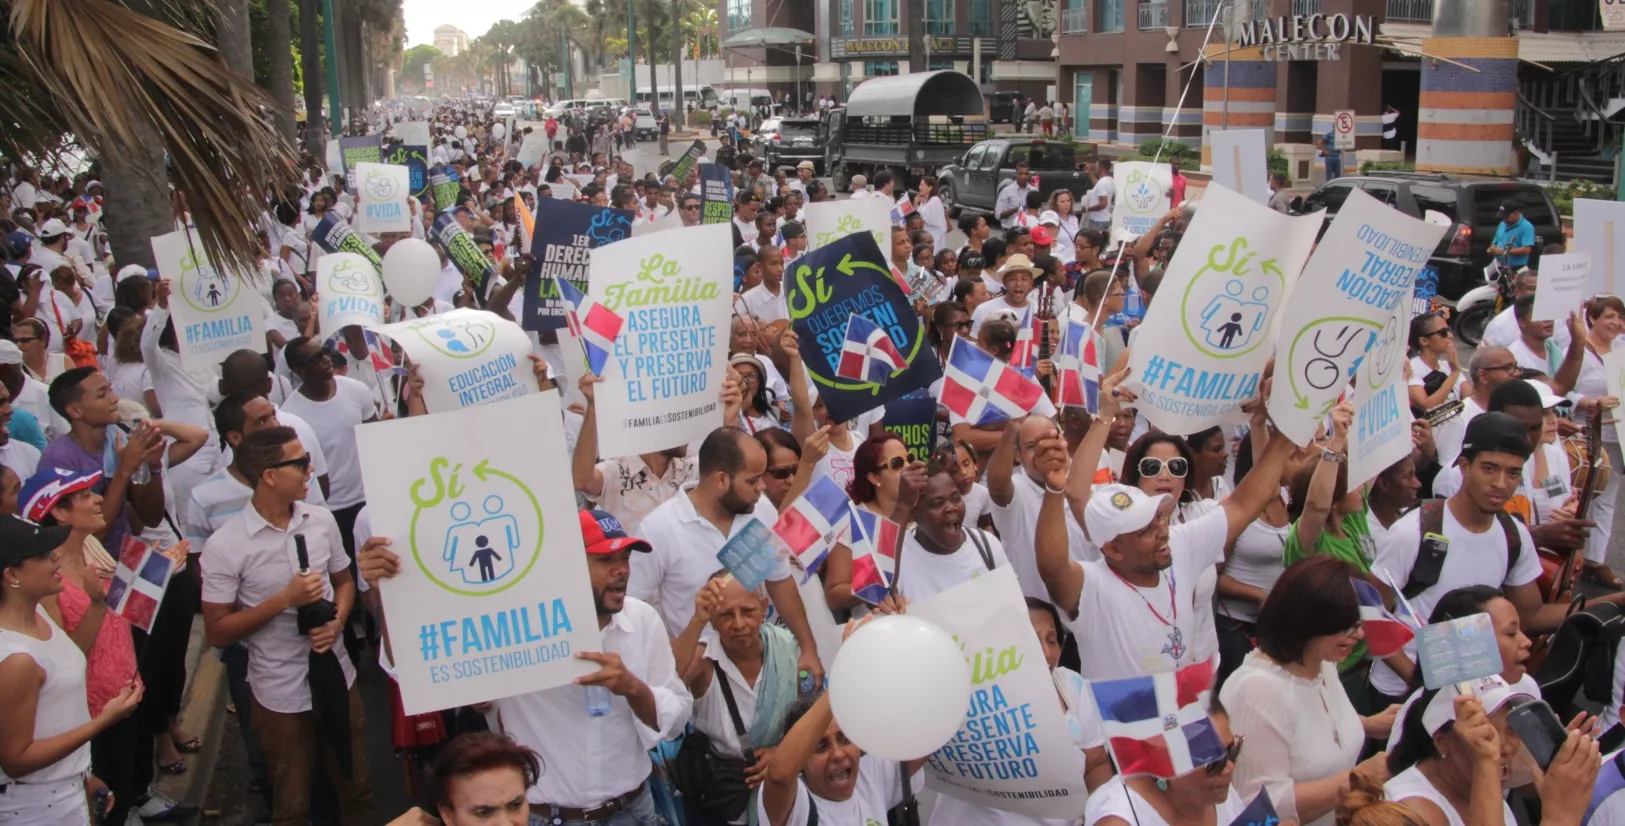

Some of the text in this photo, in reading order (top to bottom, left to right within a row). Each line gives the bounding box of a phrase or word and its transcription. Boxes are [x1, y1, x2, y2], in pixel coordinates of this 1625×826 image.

[1238, 13, 1375, 47] MALECON
[1263, 43, 1341, 61] CENTER
[366, 202, 401, 217] #VIDA
[572, 234, 590, 247] 1ER
[1208, 236, 1258, 276] Sí
[637, 253, 682, 284] La
[326, 296, 379, 320] #VIDA
[603, 276, 722, 311] Familia
[788, 264, 833, 320] Sí
[806, 285, 885, 326] QUEREMOS
[185, 315, 253, 344] #FAMILIA
[628, 305, 702, 332] ASEGURA
[614, 326, 716, 357] EL PRESENTE
[448, 352, 517, 393] EDUCACIÓN
[619, 349, 712, 379] Y PRESERVA
[1141, 354, 1260, 400] #FAMILIA
[458, 373, 517, 407] INTEGRAL
[627, 371, 707, 402] EL FUTURO
[1141, 388, 1154, 404] ES
[1358, 383, 1400, 444] #VIDA
[409, 456, 466, 508] Sí
[419, 598, 573, 661] #FAMILIA
[430, 641, 571, 684] ES SOSTENIBILIDAD
[956, 757, 1039, 780] FUTURO
